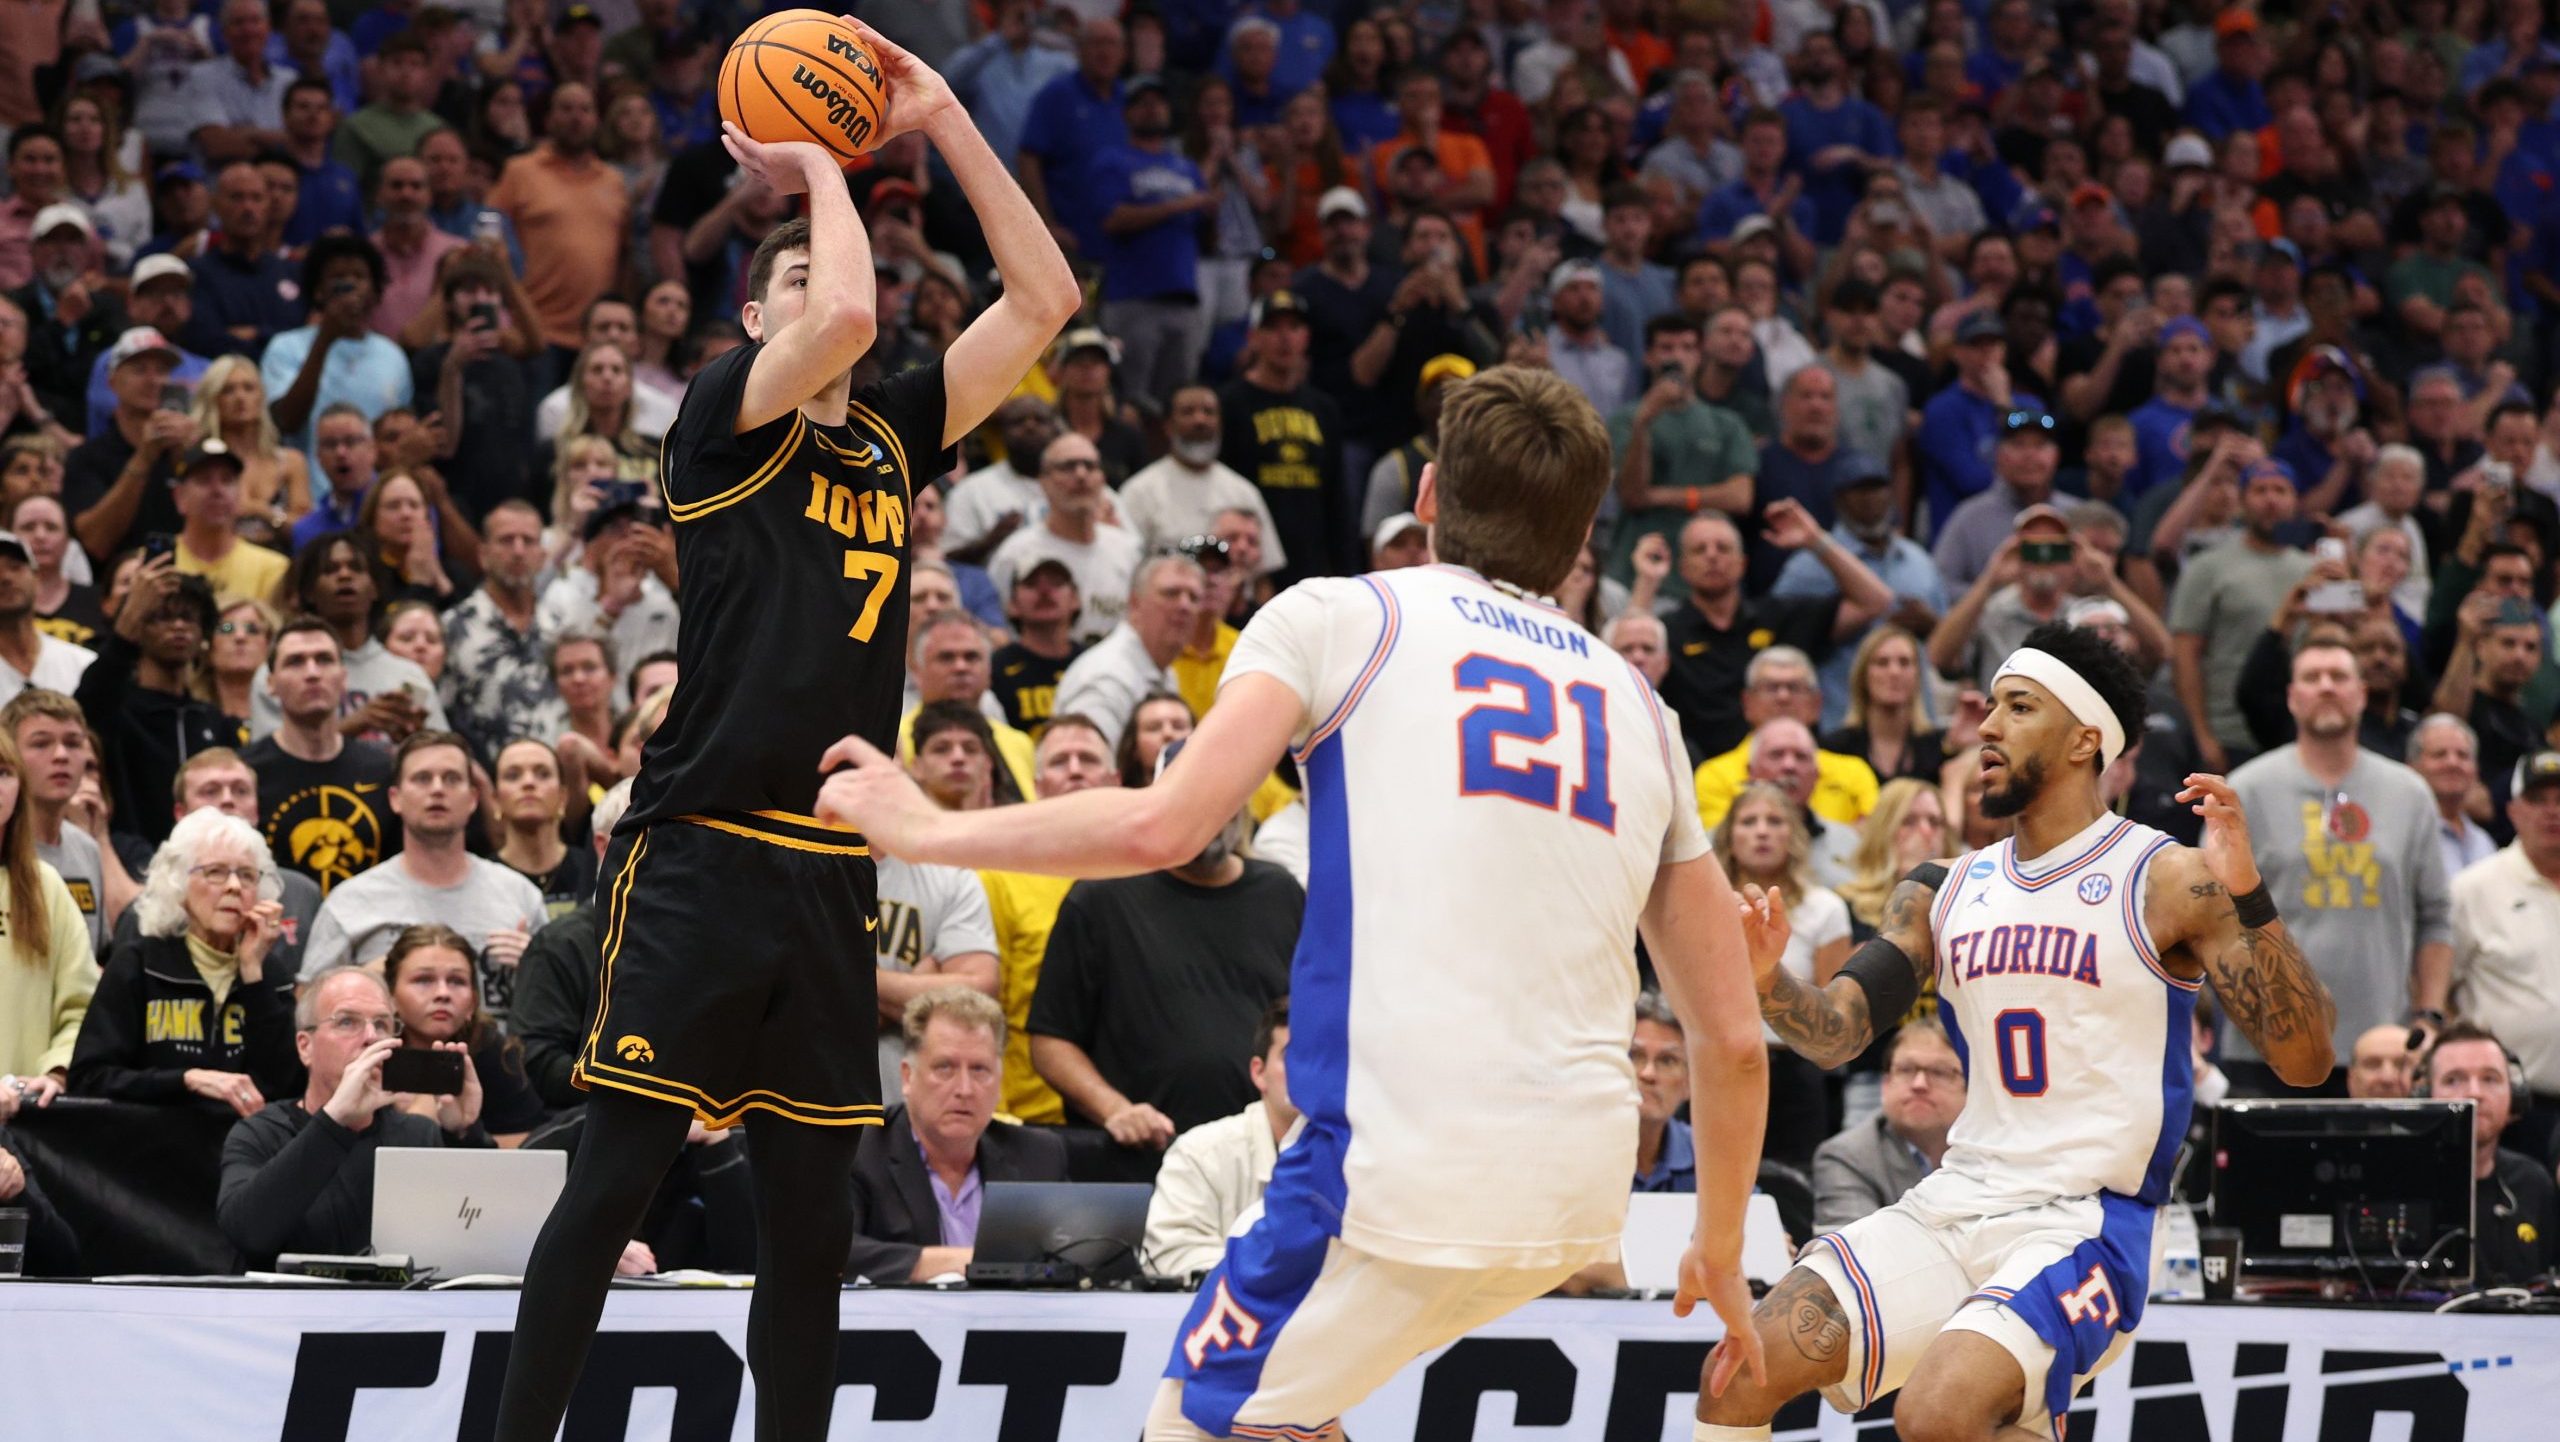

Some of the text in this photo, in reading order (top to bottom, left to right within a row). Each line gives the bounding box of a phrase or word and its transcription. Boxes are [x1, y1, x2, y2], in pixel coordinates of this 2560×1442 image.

[827, 33, 883, 93] NCAA
[792, 63, 872, 148] Wilson
[804, 471, 906, 548] IOWA
[843, 549, 900, 644] 7
[1451, 595, 1589, 660] CONDON
[1452, 651, 1618, 837] 21
[2080, 876, 2110, 902] SEC
[1950, 924, 2101, 988] FLORIDA
[1994, 1008, 2049, 1097] 0
[458, 1196, 482, 1230] hp
